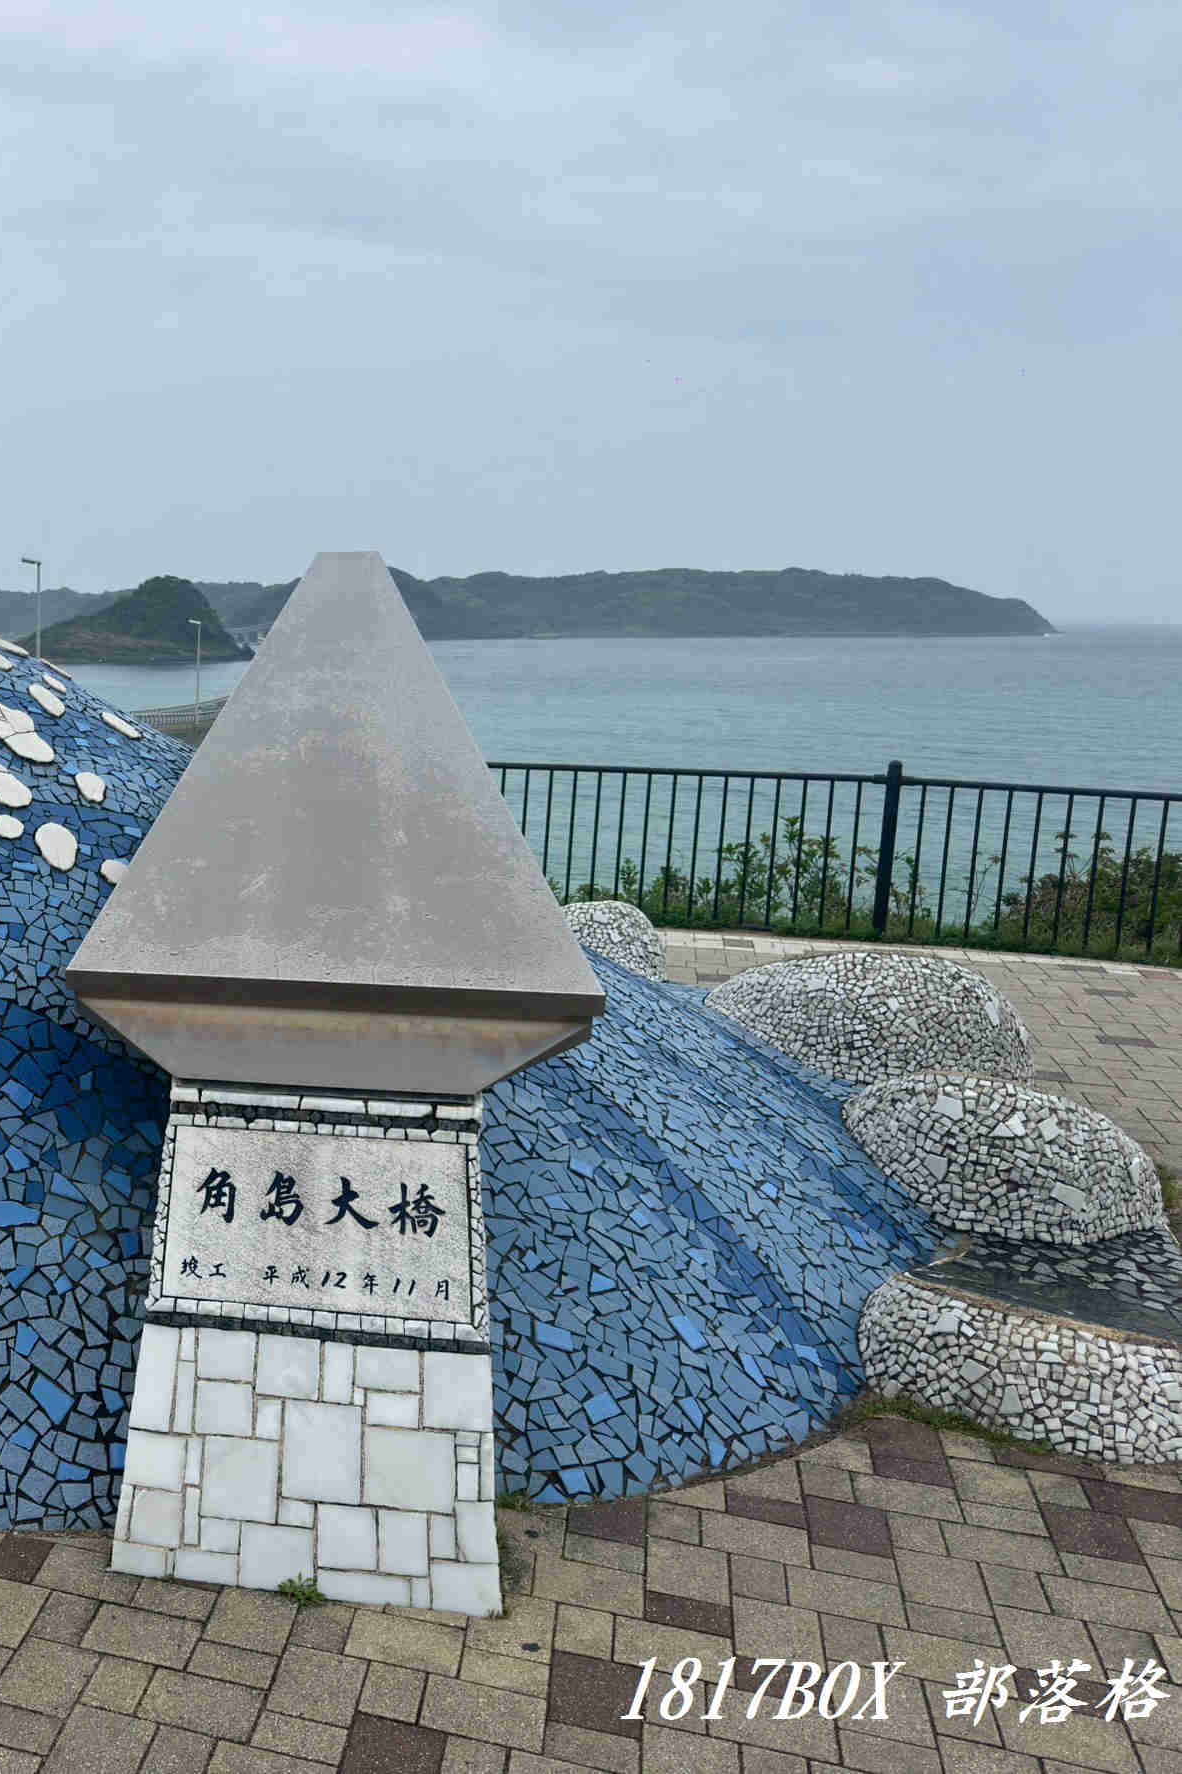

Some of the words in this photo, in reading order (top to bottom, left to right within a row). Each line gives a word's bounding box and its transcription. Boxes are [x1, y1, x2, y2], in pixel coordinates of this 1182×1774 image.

[196, 1167, 445, 1238] 角島大橋
[180, 1255, 227, 1279] 竣工
